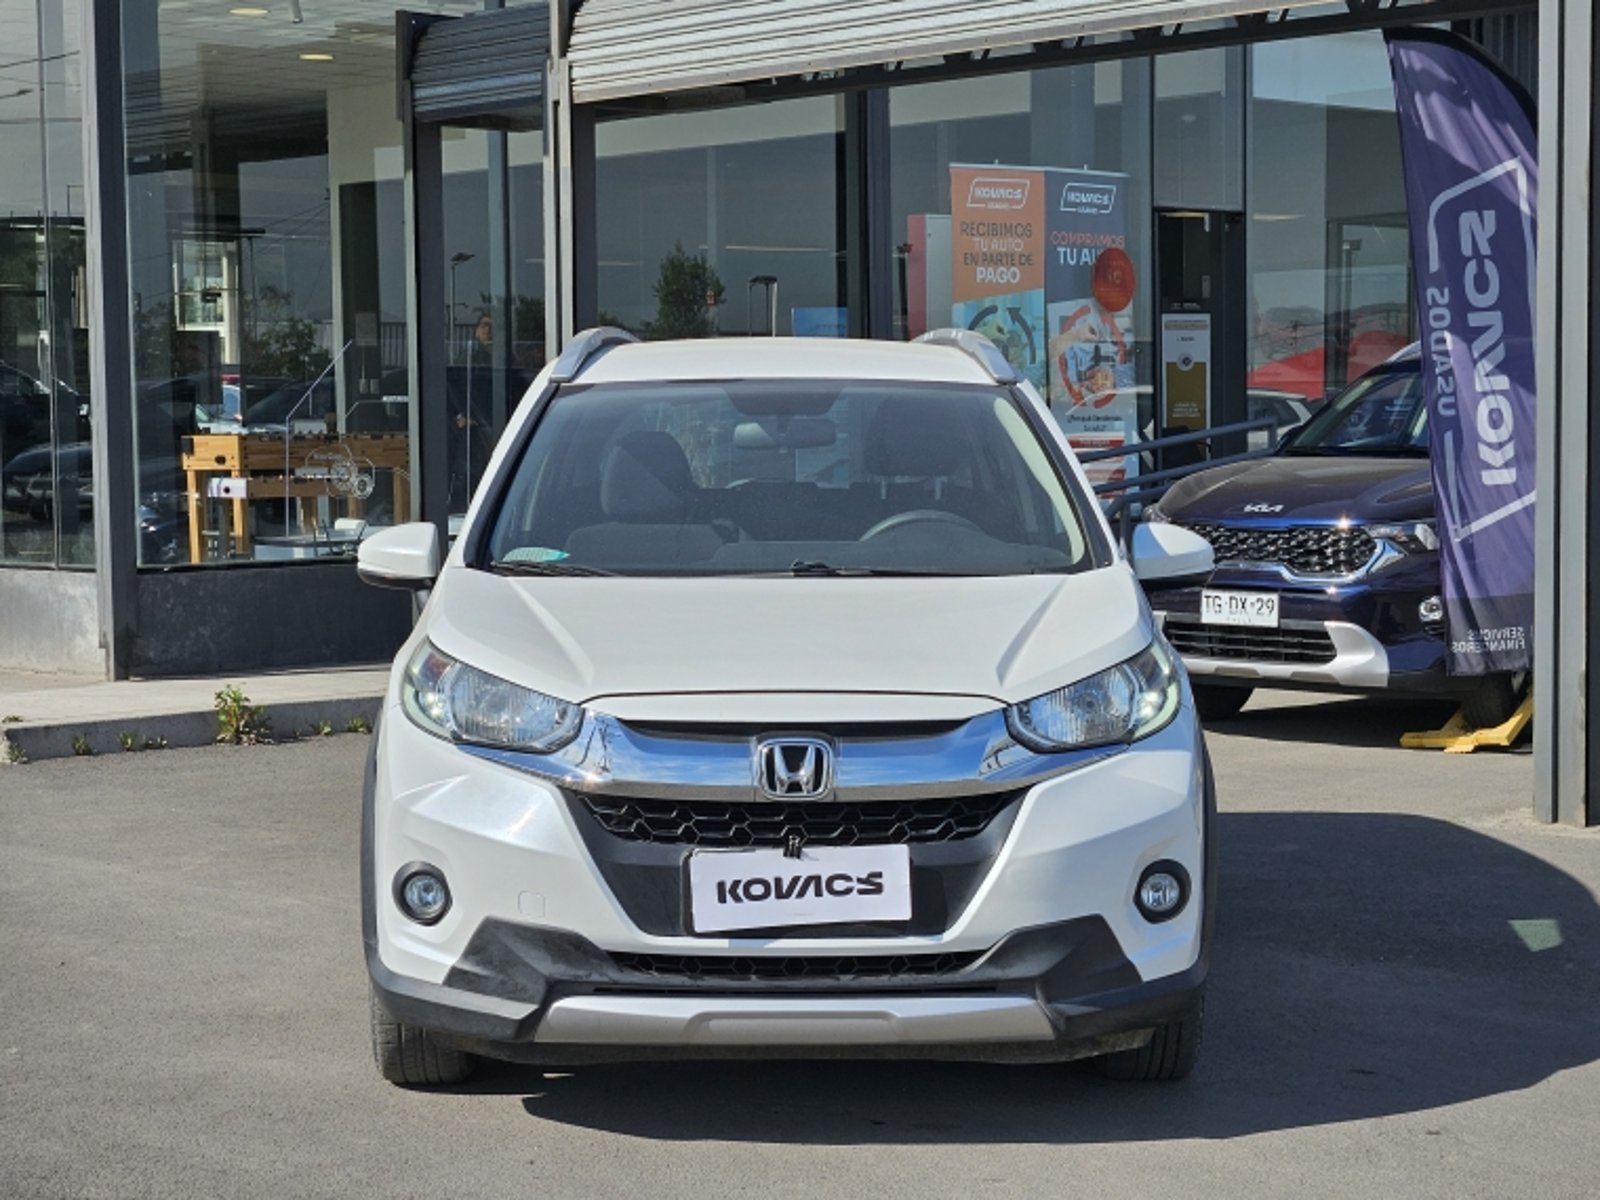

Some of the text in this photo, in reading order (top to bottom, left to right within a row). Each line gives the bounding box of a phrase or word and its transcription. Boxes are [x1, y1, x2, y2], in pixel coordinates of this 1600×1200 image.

[960, 221, 1033, 238] RECIBIMOS
[973, 238, 1024, 252] TU AUTO
[1051, 231, 1125, 249] COMPRAMOS
[964, 252, 1033, 266] EN PARTE DE
[1056, 246, 1077, 266] TU
[976, 266, 1020, 284] PAGO
[716, 871, 884, 905] KOVACS
